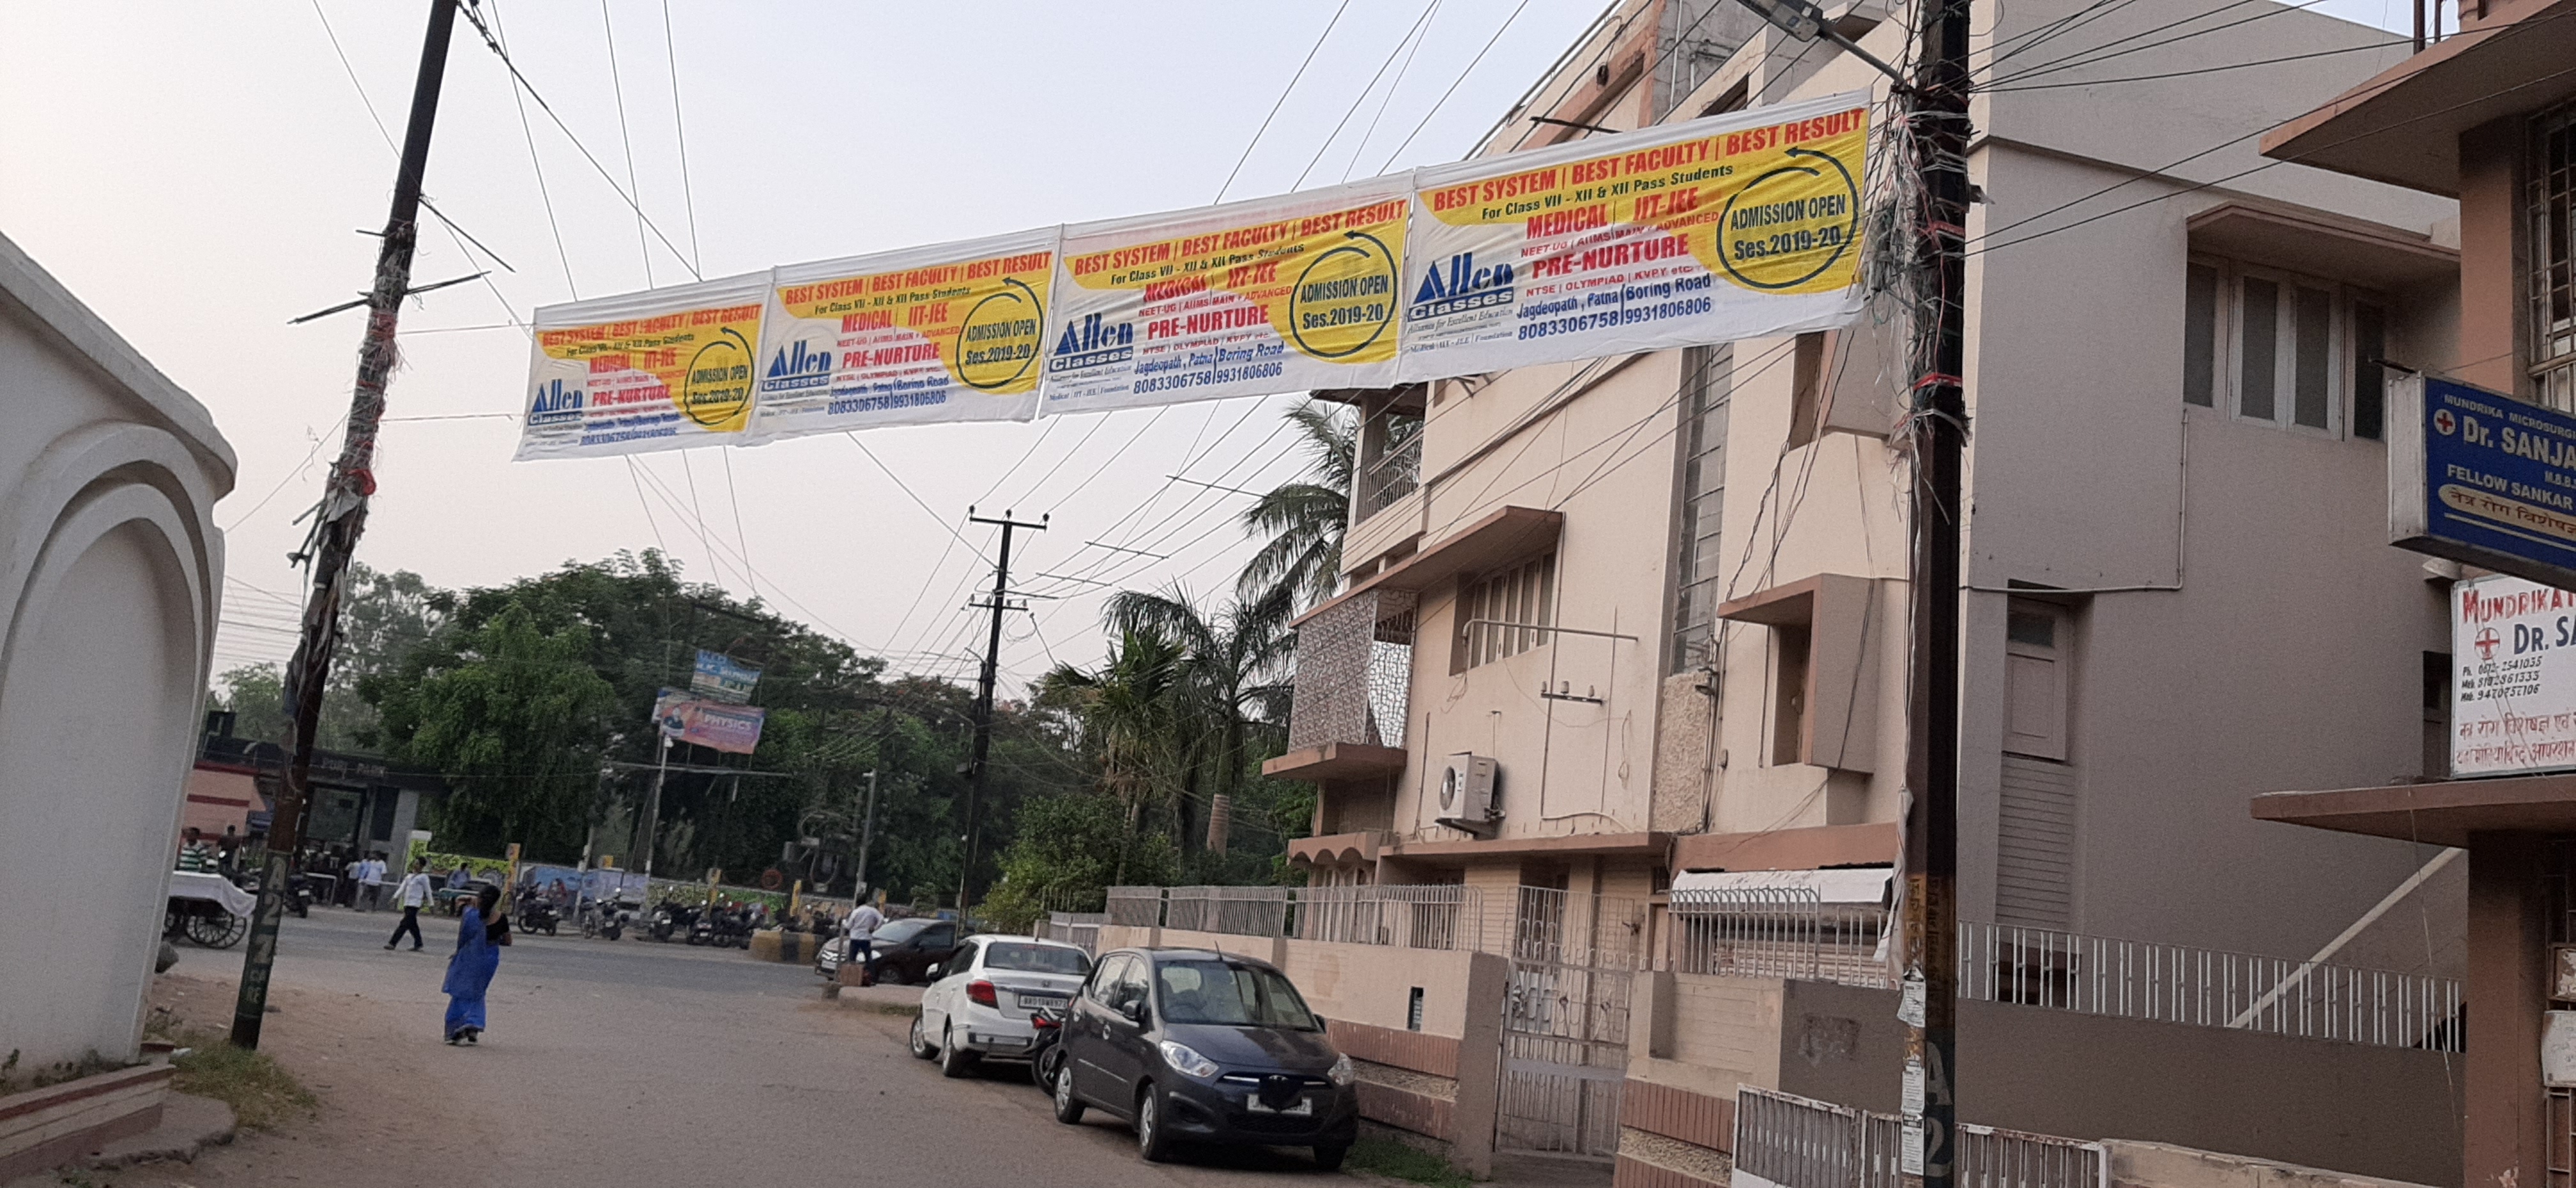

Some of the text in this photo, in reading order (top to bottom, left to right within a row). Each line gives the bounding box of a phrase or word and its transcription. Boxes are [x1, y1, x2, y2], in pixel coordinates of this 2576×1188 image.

[1434, 109, 1865, 211] BEST SYSTEM BEST FACULTY BEST RESULT
[1482, 165, 1733, 219] For Class VII XII & XII Pass Students
[1527, 187, 1698, 239] MEDICAL IIT-JEE
[1731, 194, 1846, 231] ADMISSION OPEN
[1075, 199, 1406, 275] BEST SYSTEM BEST FACULTY BEST RESULT
[1577, 234, 1611, 247] AIIMS
[1615, 227, 1644, 238] MAIN
[1656, 212, 1719, 230] ADVANCED
[1735, 226, 1840, 260] Ses.2019-20
[1112, 274, 1127, 285] For
[1130, 270, 1156, 282] Class
[1160, 266, 1172, 277] VII
[1183, 261, 1196, 272] XII
[1229, 254, 1254, 263] Pass
[1533, 234, 1689, 278] PRE-NURTURE
[786, 252, 1052, 305] BEST SYSTEM BEST FACULTY BEST RESULT
[1144, 275, 1207, 303] MEDICAL
[1300, 275, 1388, 303] ADMISSION OPEN
[1413, 252, 1514, 304] Allen
[1526, 286, 1555, 297] NTSE
[1565, 275, 1623, 291] OLYMPIAD
[1588, 291, 1618, 308] Patna
[1626, 280, 1670, 300] Boring
[1675, 273, 1710, 291] Road
[815, 305, 827, 315] For
[830, 302, 851, 312] Class
[910, 292, 929, 302] Pass
[1139, 303, 1176, 317] NEET-UG
[1184, 298, 1209, 310] AIIMS
[1245, 286, 1292, 300] ADVANCED
[1303, 303, 1383, 329] Ses.2019-20
[1409, 291, 1513, 320] Classes
[543, 331, 565, 346] BEST
[613, 321, 638, 337] BEST
[692, 309, 720, 326] BEST
[842, 303, 949, 333] MEDICAL IIT-JEE
[966, 319, 1036, 342] ADMISSION OPEN
[1054, 312, 1133, 356] Allen
[1148, 305, 1268, 340] PRE-NURTURE
[1518, 311, 1618, 340] 8083306758
[1625, 297, 1711, 324] 9931806806
[767, 340, 831, 378] Allen
[843, 342, 940, 369] PRE-NURTURE
[1051, 350, 1132, 370] Classes
[1188, 353, 1213, 367] Patna
[1218, 346, 1254, 362] Boring
[1257, 341, 1284, 356] Road
[532, 379, 583, 412] Allen
[593, 385, 671, 406] PRE-NURTURE
[764, 375, 829, 390] Classes
[1133, 370, 1211, 394] 8083306758
[2444, 394, 2504, 418] MUNDRIKA
[2463, 416, 2494, 448] Dr.
[2447, 464, 2573, 510] FELLOW SANKAR
[2449, 487, 2476, 506] नेत्र
[2480, 496, 2511, 515] रोग
[2463, 588, 2563, 623] MUNDRIKA
[703, 714, 753, 731] PHYSICS
